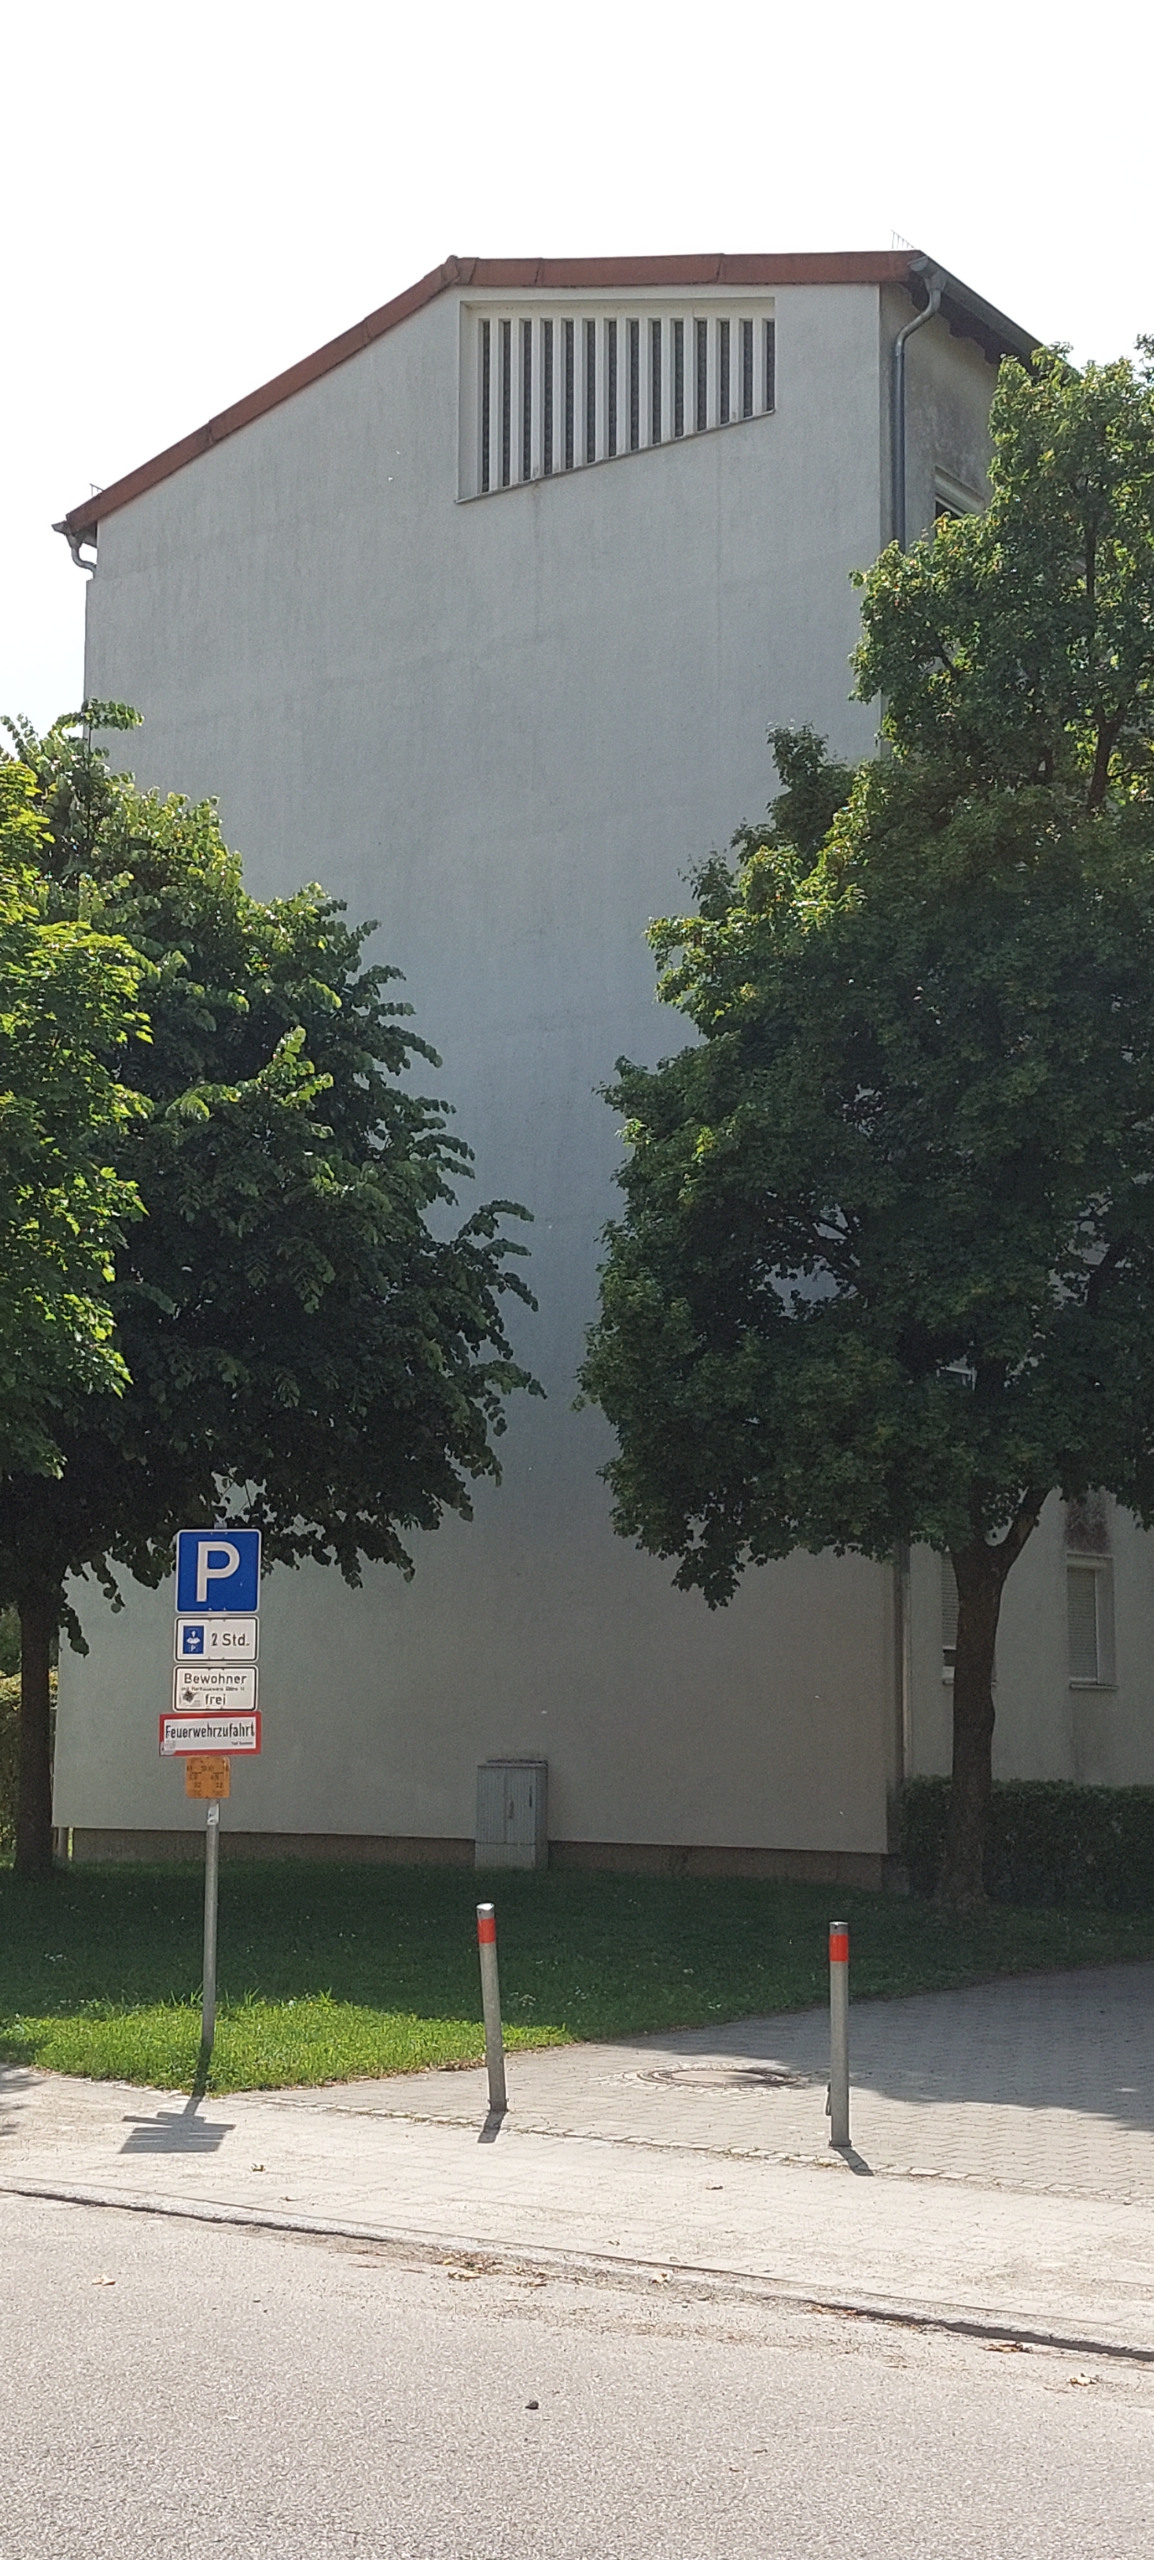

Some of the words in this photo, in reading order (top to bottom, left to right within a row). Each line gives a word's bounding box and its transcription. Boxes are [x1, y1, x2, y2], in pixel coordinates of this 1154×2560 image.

[196, 1541, 240, 1602] P
[211, 1633, 218, 1646] 2
[222, 1633, 250, 1646] Std.
[184, 1672, 248, 1685] Bewohner
[205, 1693, 226, 1706] frei
[165, 1723, 255, 1739] Feuerwehrzufahrt
